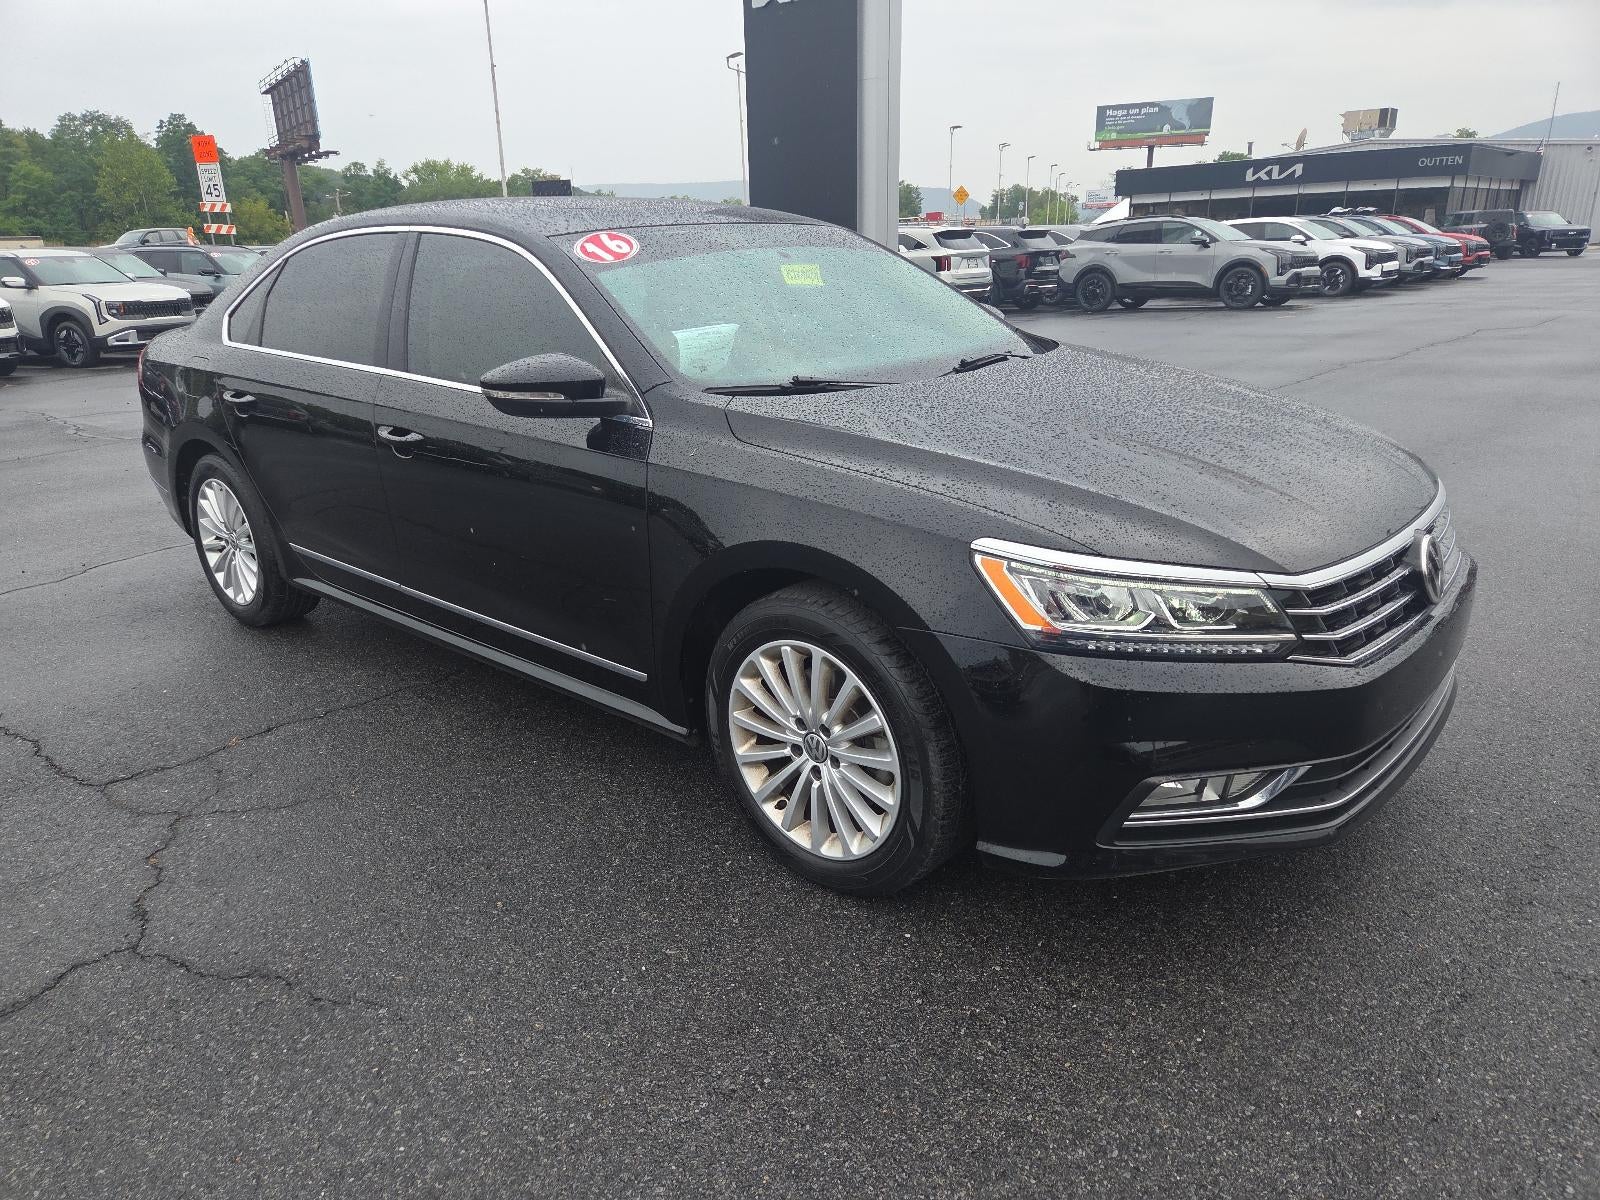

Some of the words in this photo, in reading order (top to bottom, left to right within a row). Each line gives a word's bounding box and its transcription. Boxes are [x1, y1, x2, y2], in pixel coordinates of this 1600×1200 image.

[1106, 109, 1127, 117] Haga
[1141, 106, 1159, 114] plan
[1418, 155, 1464, 167] OUTTEN
[1245, 163, 1304, 182] KIA
[205, 183, 221, 198] 45
[583, 233, 632, 261] 16
